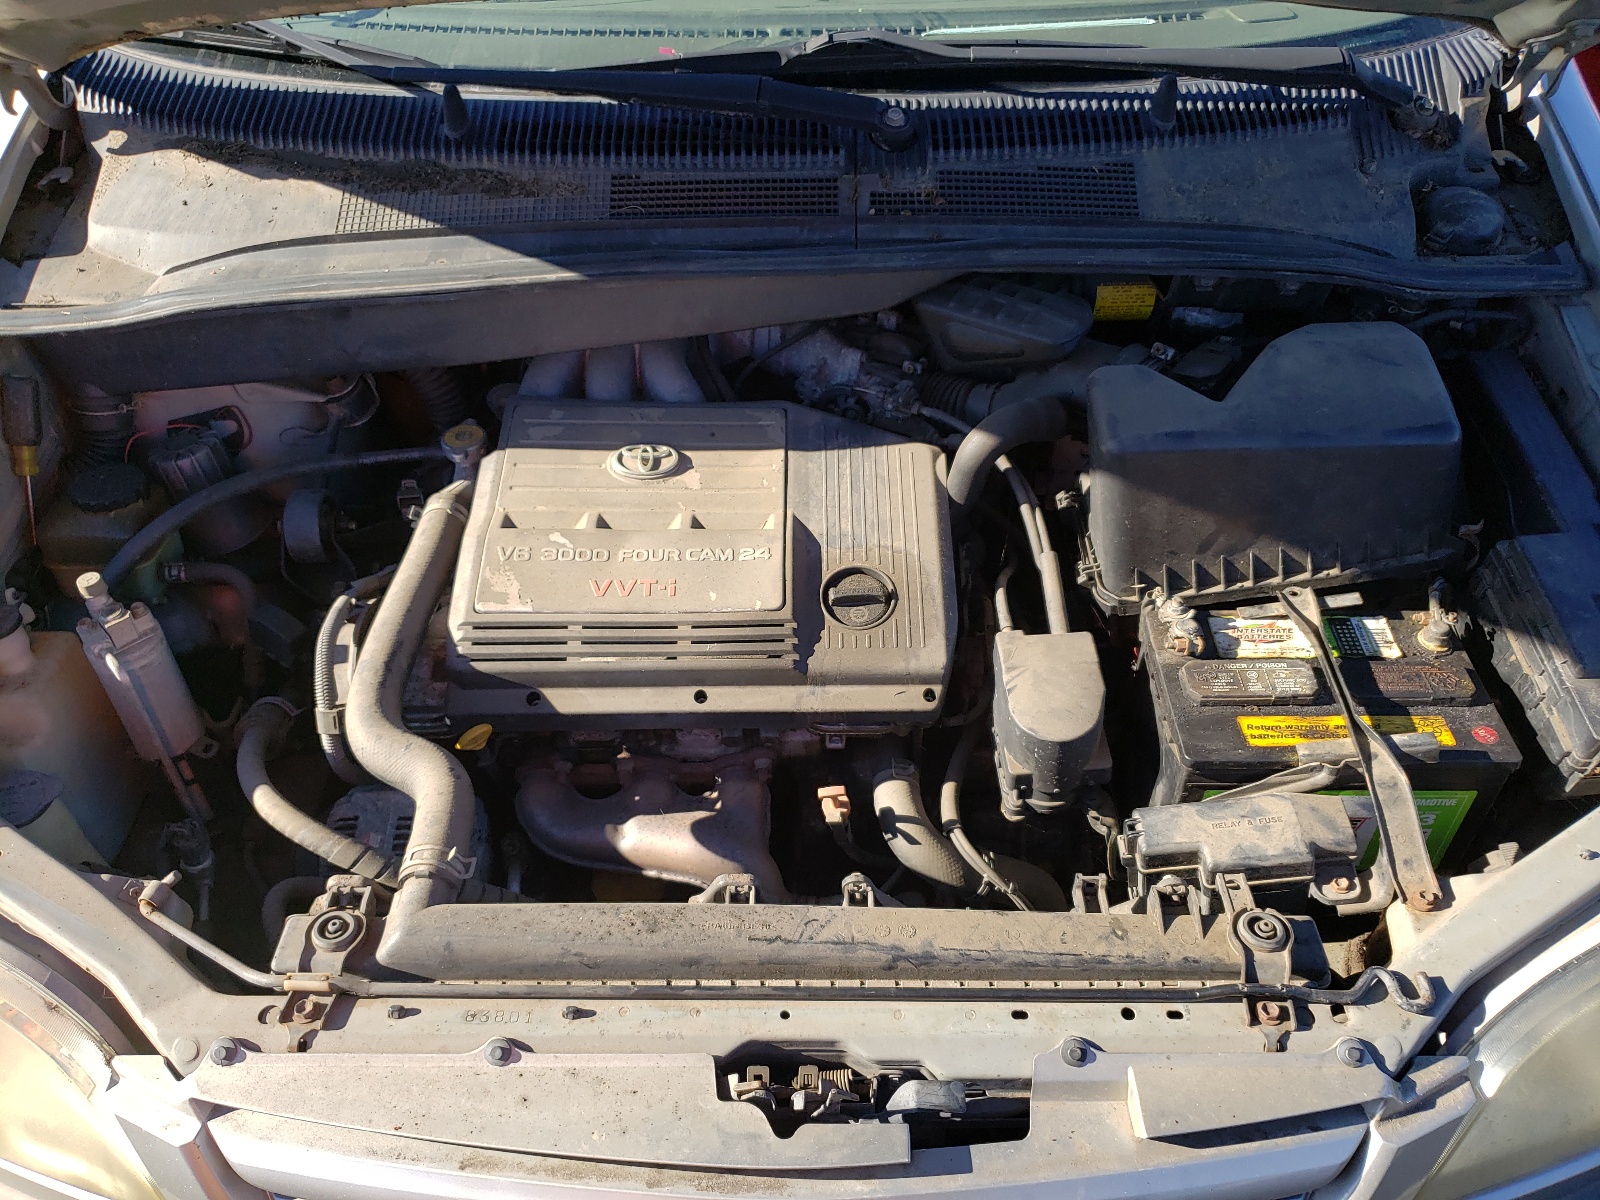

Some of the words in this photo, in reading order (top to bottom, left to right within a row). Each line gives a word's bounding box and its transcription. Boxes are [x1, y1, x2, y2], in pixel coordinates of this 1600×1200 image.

[497, 546, 532, 562] V6
[540, 546, 612, 562] 3000
[618, 547, 682, 562] FOUR
[685, 547, 735, 561] CAM
[738, 546, 772, 561] 24
[589, 578, 677, 597] VVT-i
[1246, 723, 1282, 731] Return
[1250, 732, 1296, 740] batteries
[1415, 798, 1459, 806] OMOTIVE
[1211, 820, 1241, 830] RELAY
[1258, 816, 1284, 825] FUSE
